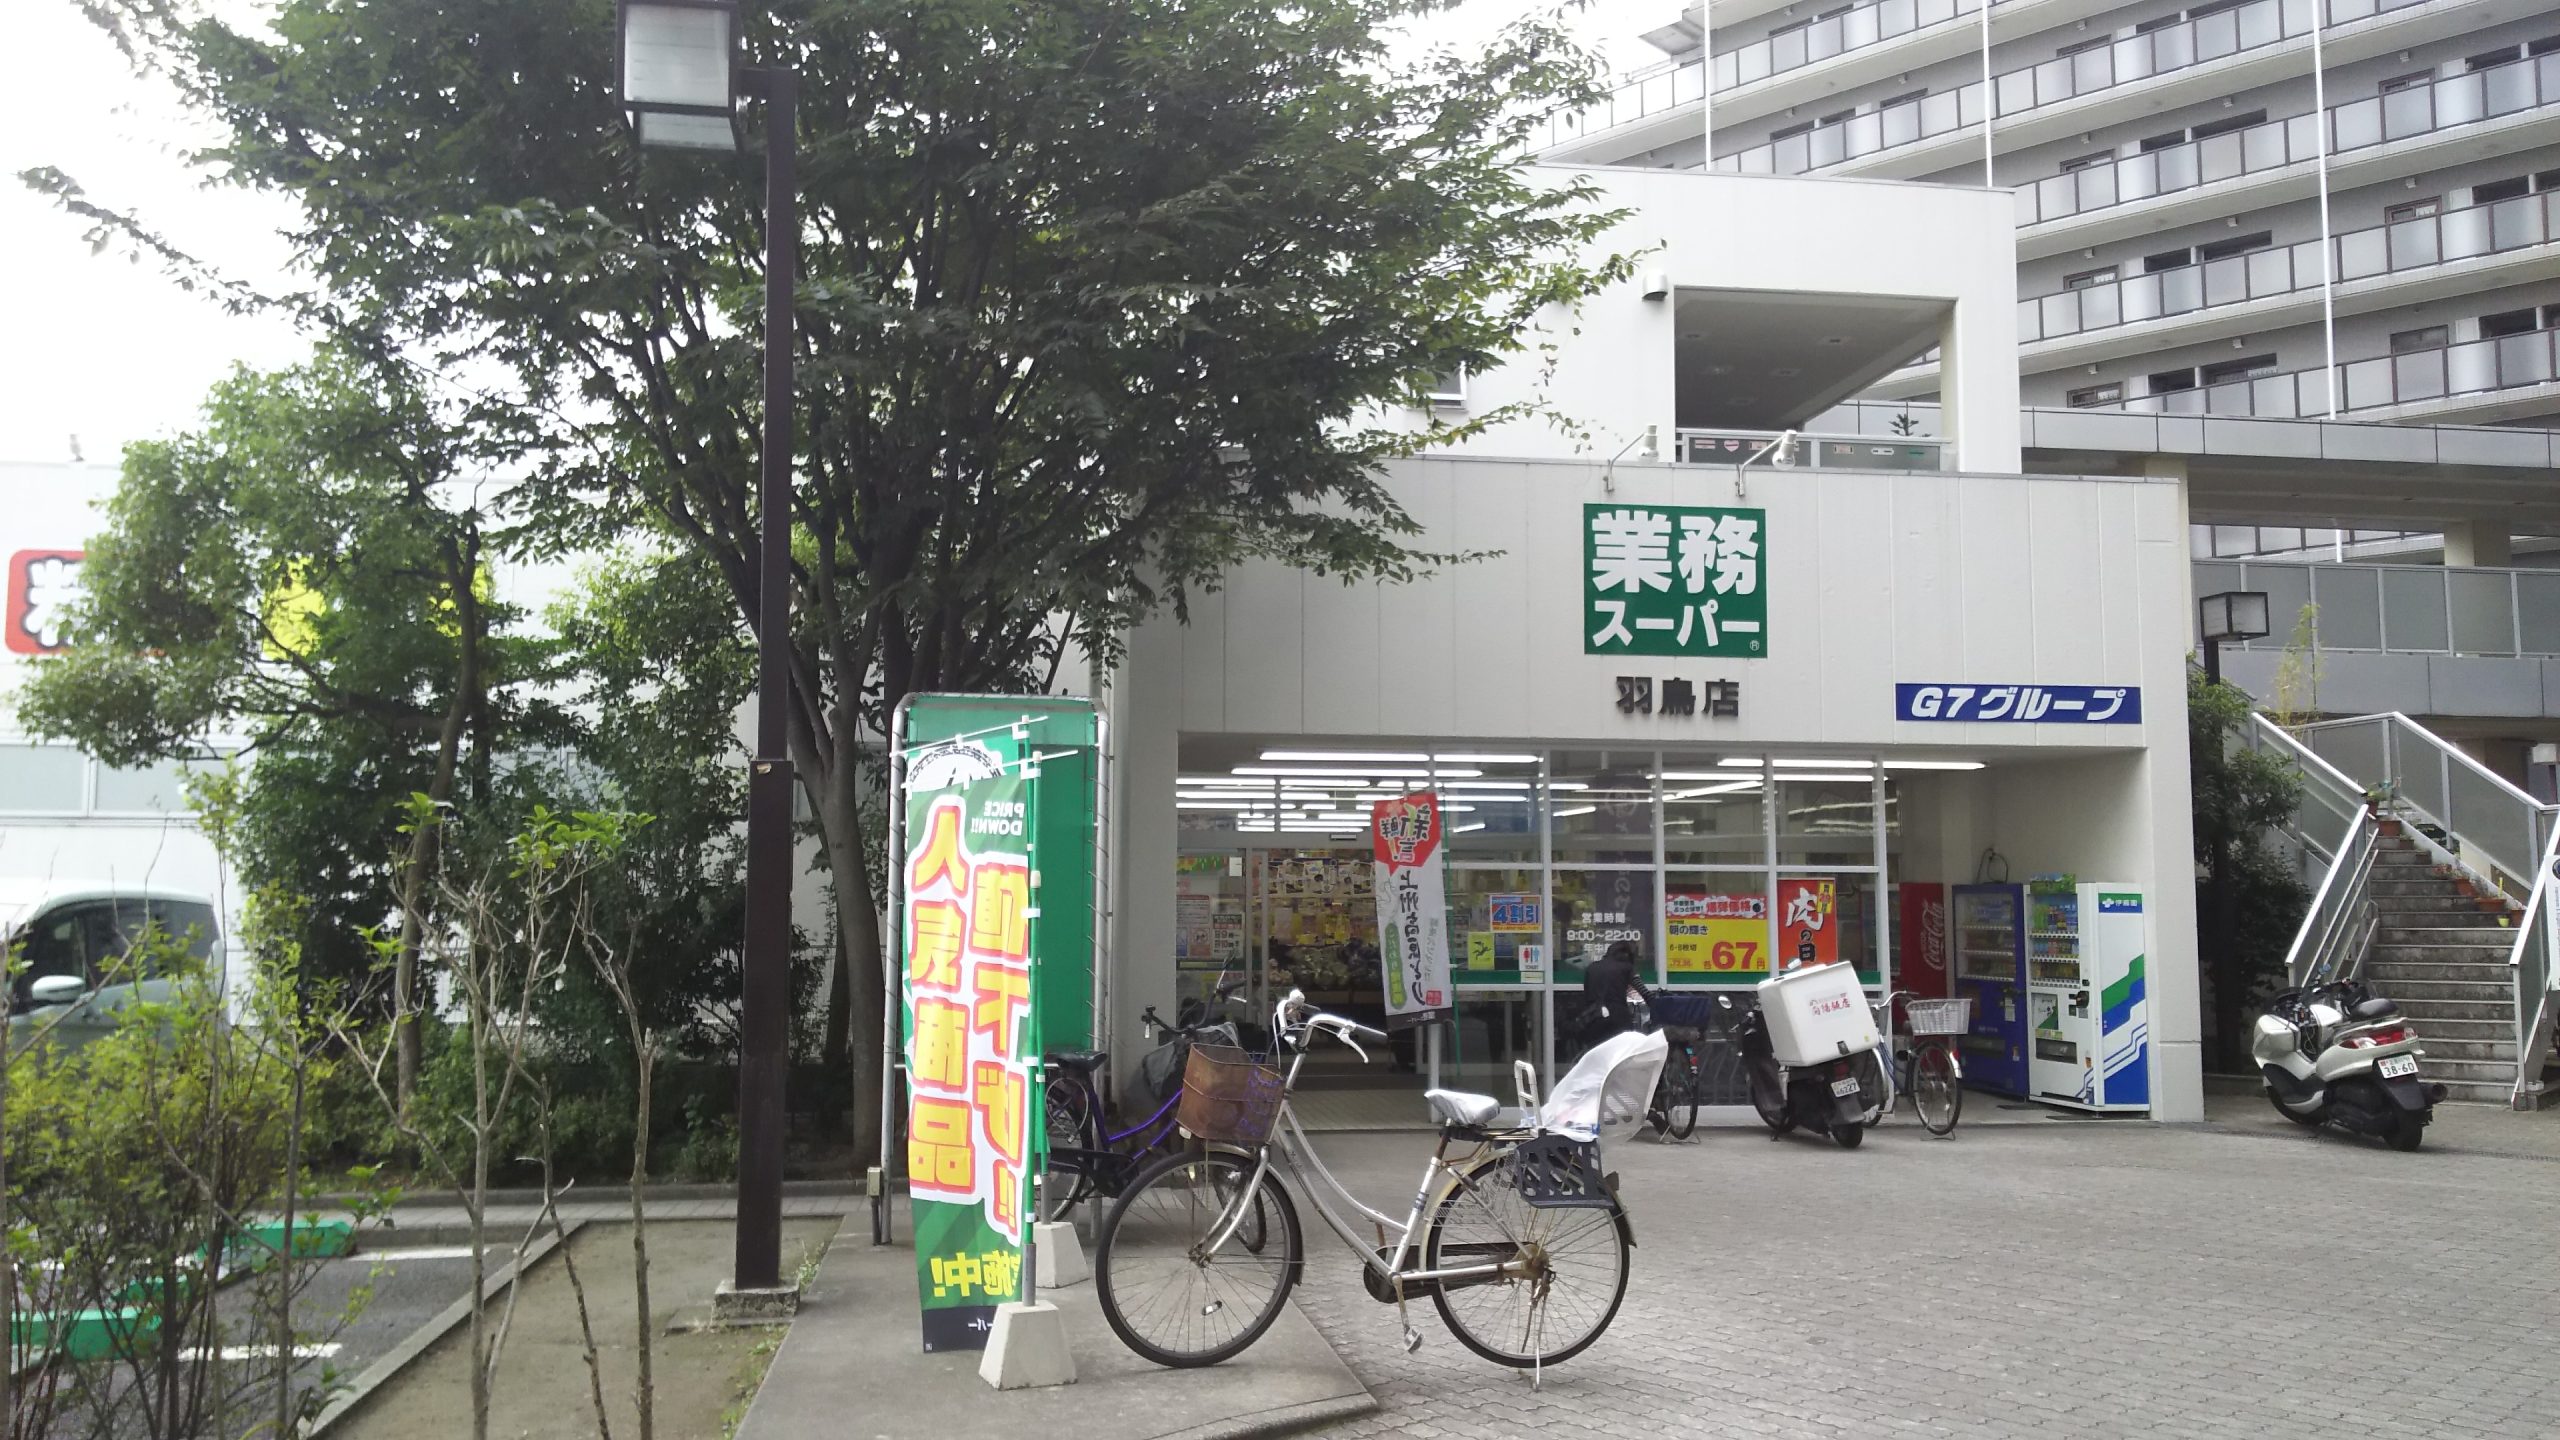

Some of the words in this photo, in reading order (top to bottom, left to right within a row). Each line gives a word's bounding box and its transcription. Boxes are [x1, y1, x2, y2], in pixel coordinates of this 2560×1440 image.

[1592, 511, 1758, 595] 業務
[1592, 598, 1760, 647] スーパー
[1911, 686, 2126, 721] G7グループ
[1493, 904, 1539, 924] 4割引
[1582, 912, 1626, 924] 営業時間
